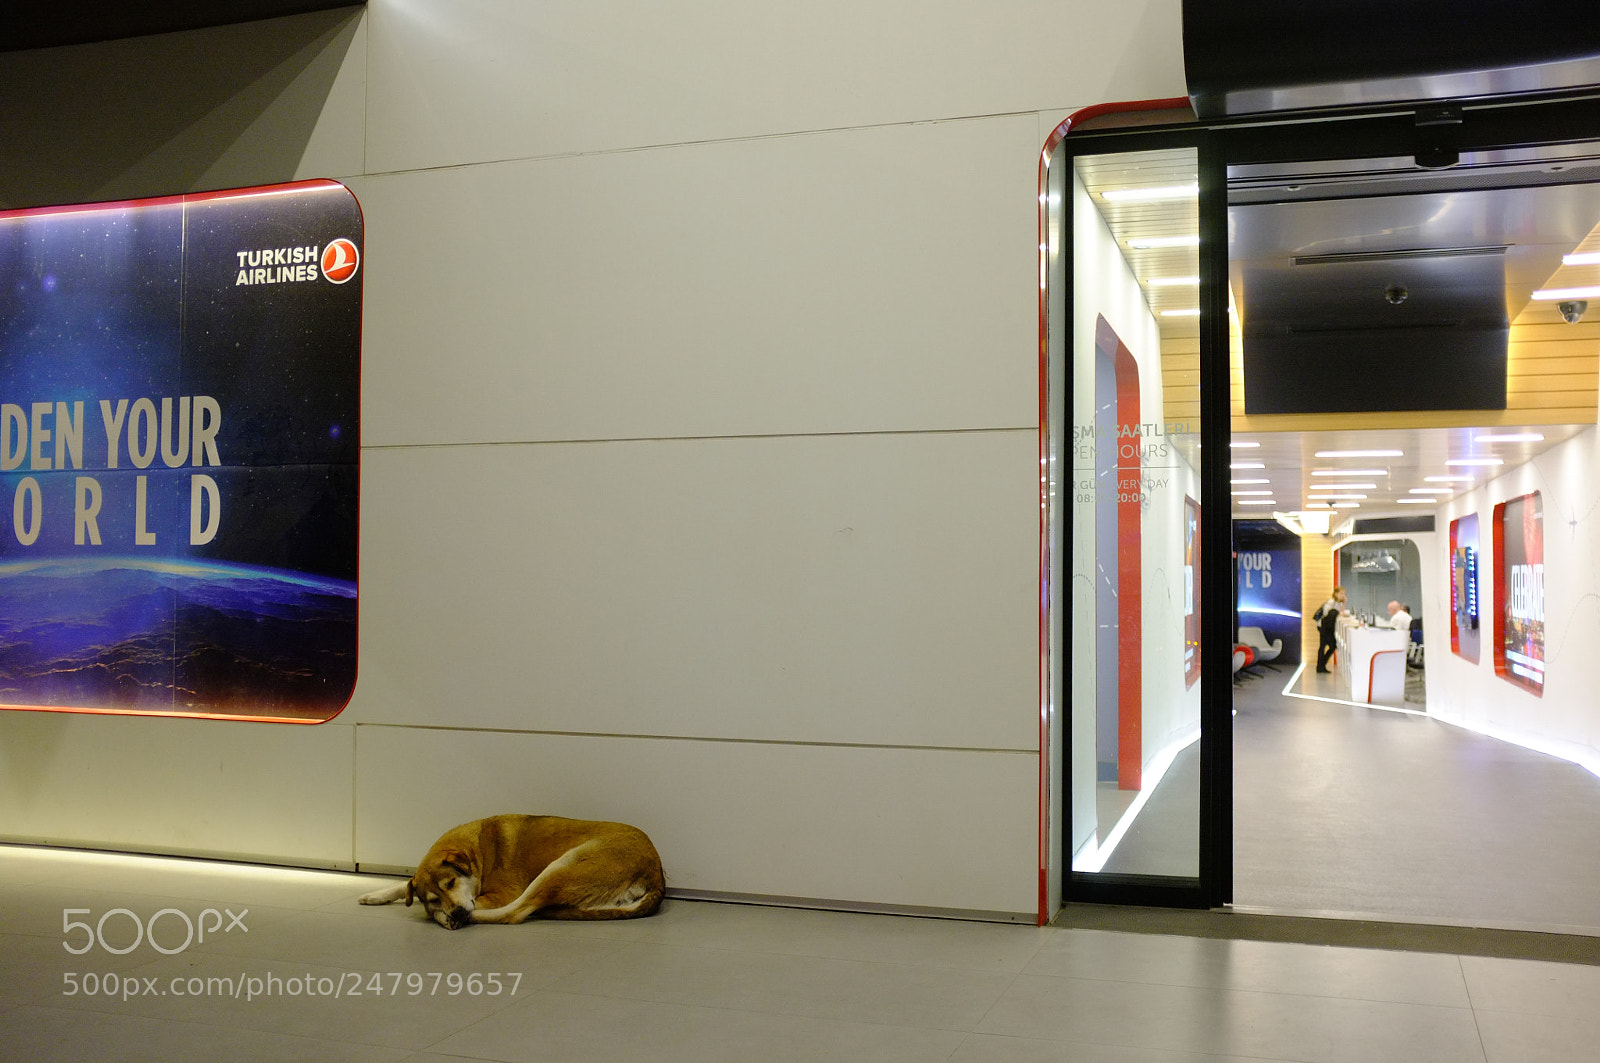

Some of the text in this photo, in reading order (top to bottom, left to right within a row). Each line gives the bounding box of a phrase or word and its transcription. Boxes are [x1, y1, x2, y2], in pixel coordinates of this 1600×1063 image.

[236, 245, 318, 268] TURKISH
[235, 264, 318, 286] AIRLINES
[0, 394, 222, 471] DEN YOUR
[1110, 479, 1142, 490] VERY
[1149, 479, 1169, 489] DAY
